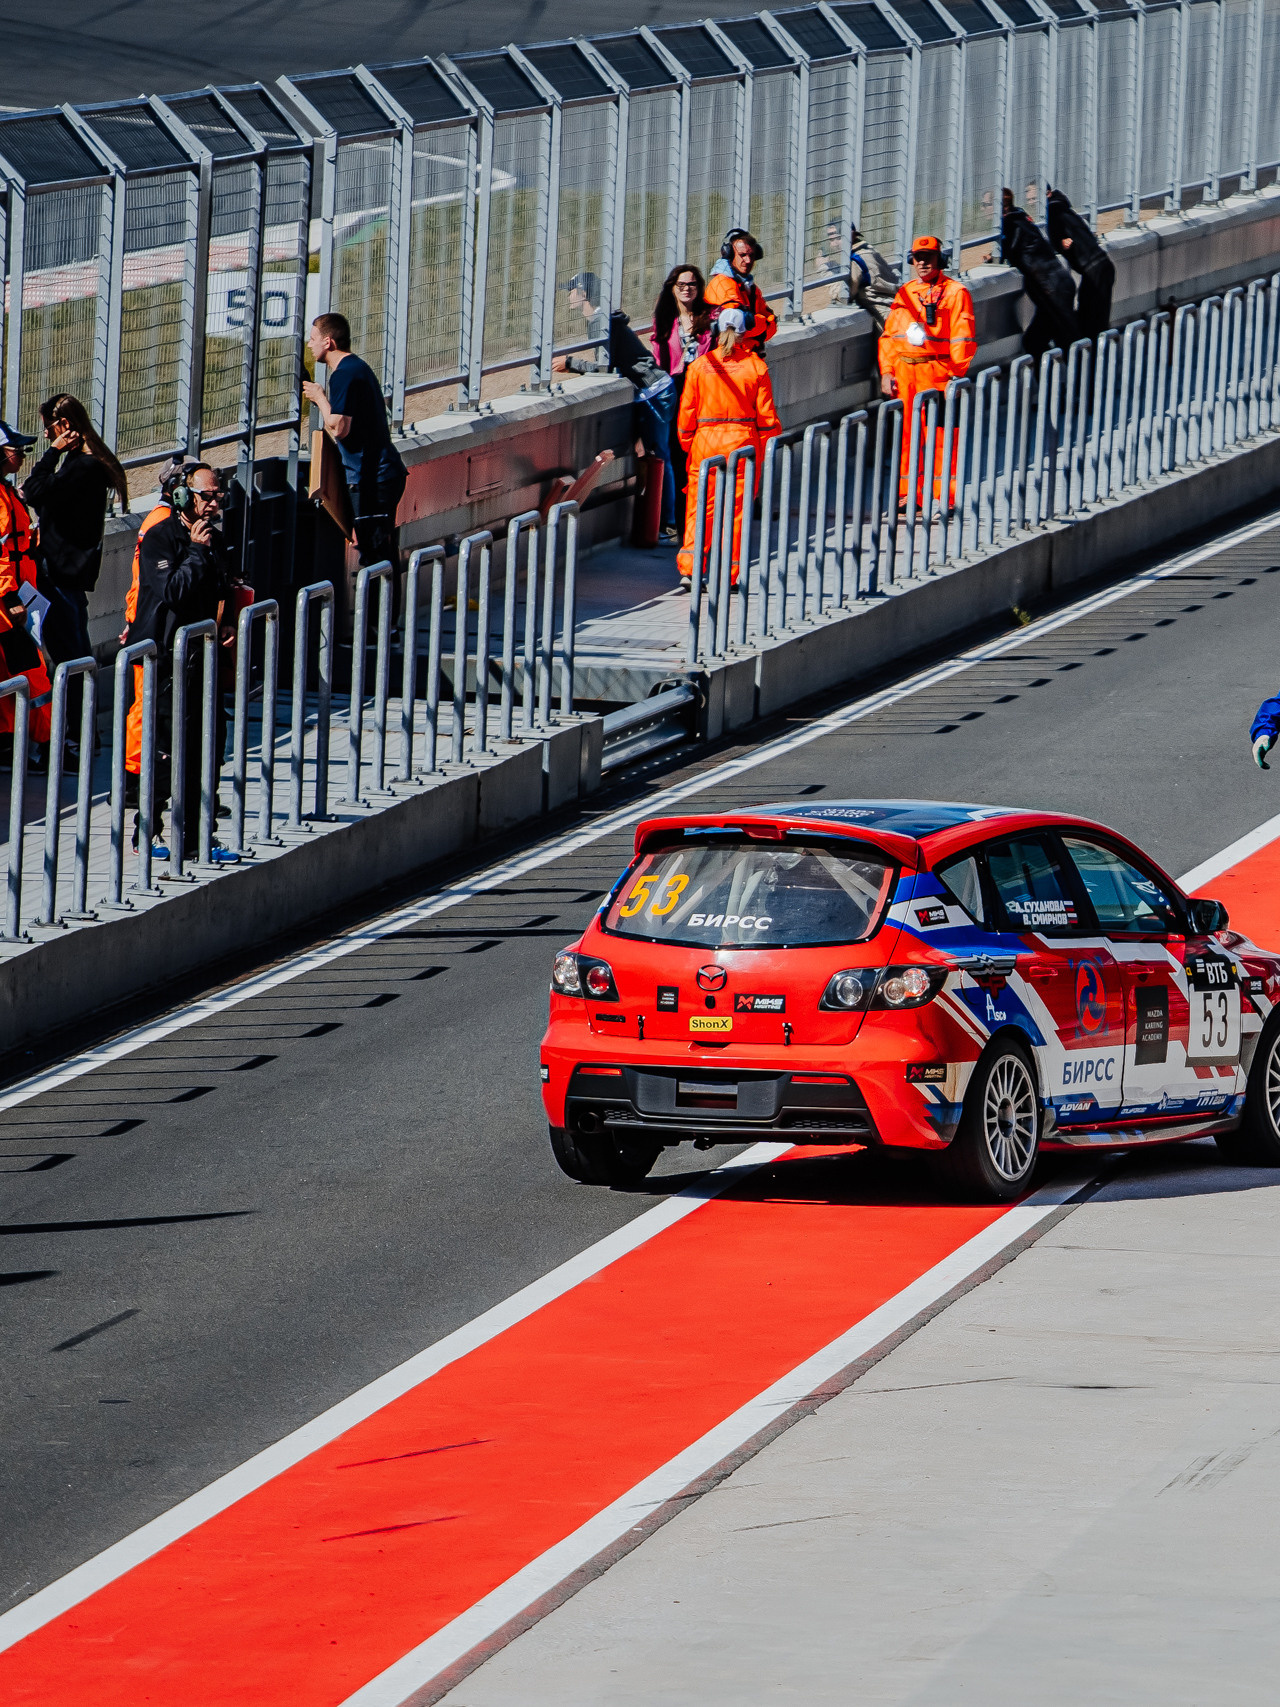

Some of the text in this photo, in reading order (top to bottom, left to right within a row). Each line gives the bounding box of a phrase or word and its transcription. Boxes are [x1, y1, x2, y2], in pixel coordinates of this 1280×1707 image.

[619, 873, 690, 918] 53
[687, 913, 773, 930] БИРСС
[1205, 961, 1229, 984] ВТБ
[691, 1019, 728, 1029] ShonX
[1201, 991, 1229, 1048] 53
[1062, 1057, 1115, 1085] БИРСС
[1059, 1102, 1091, 1112] ADVAN
